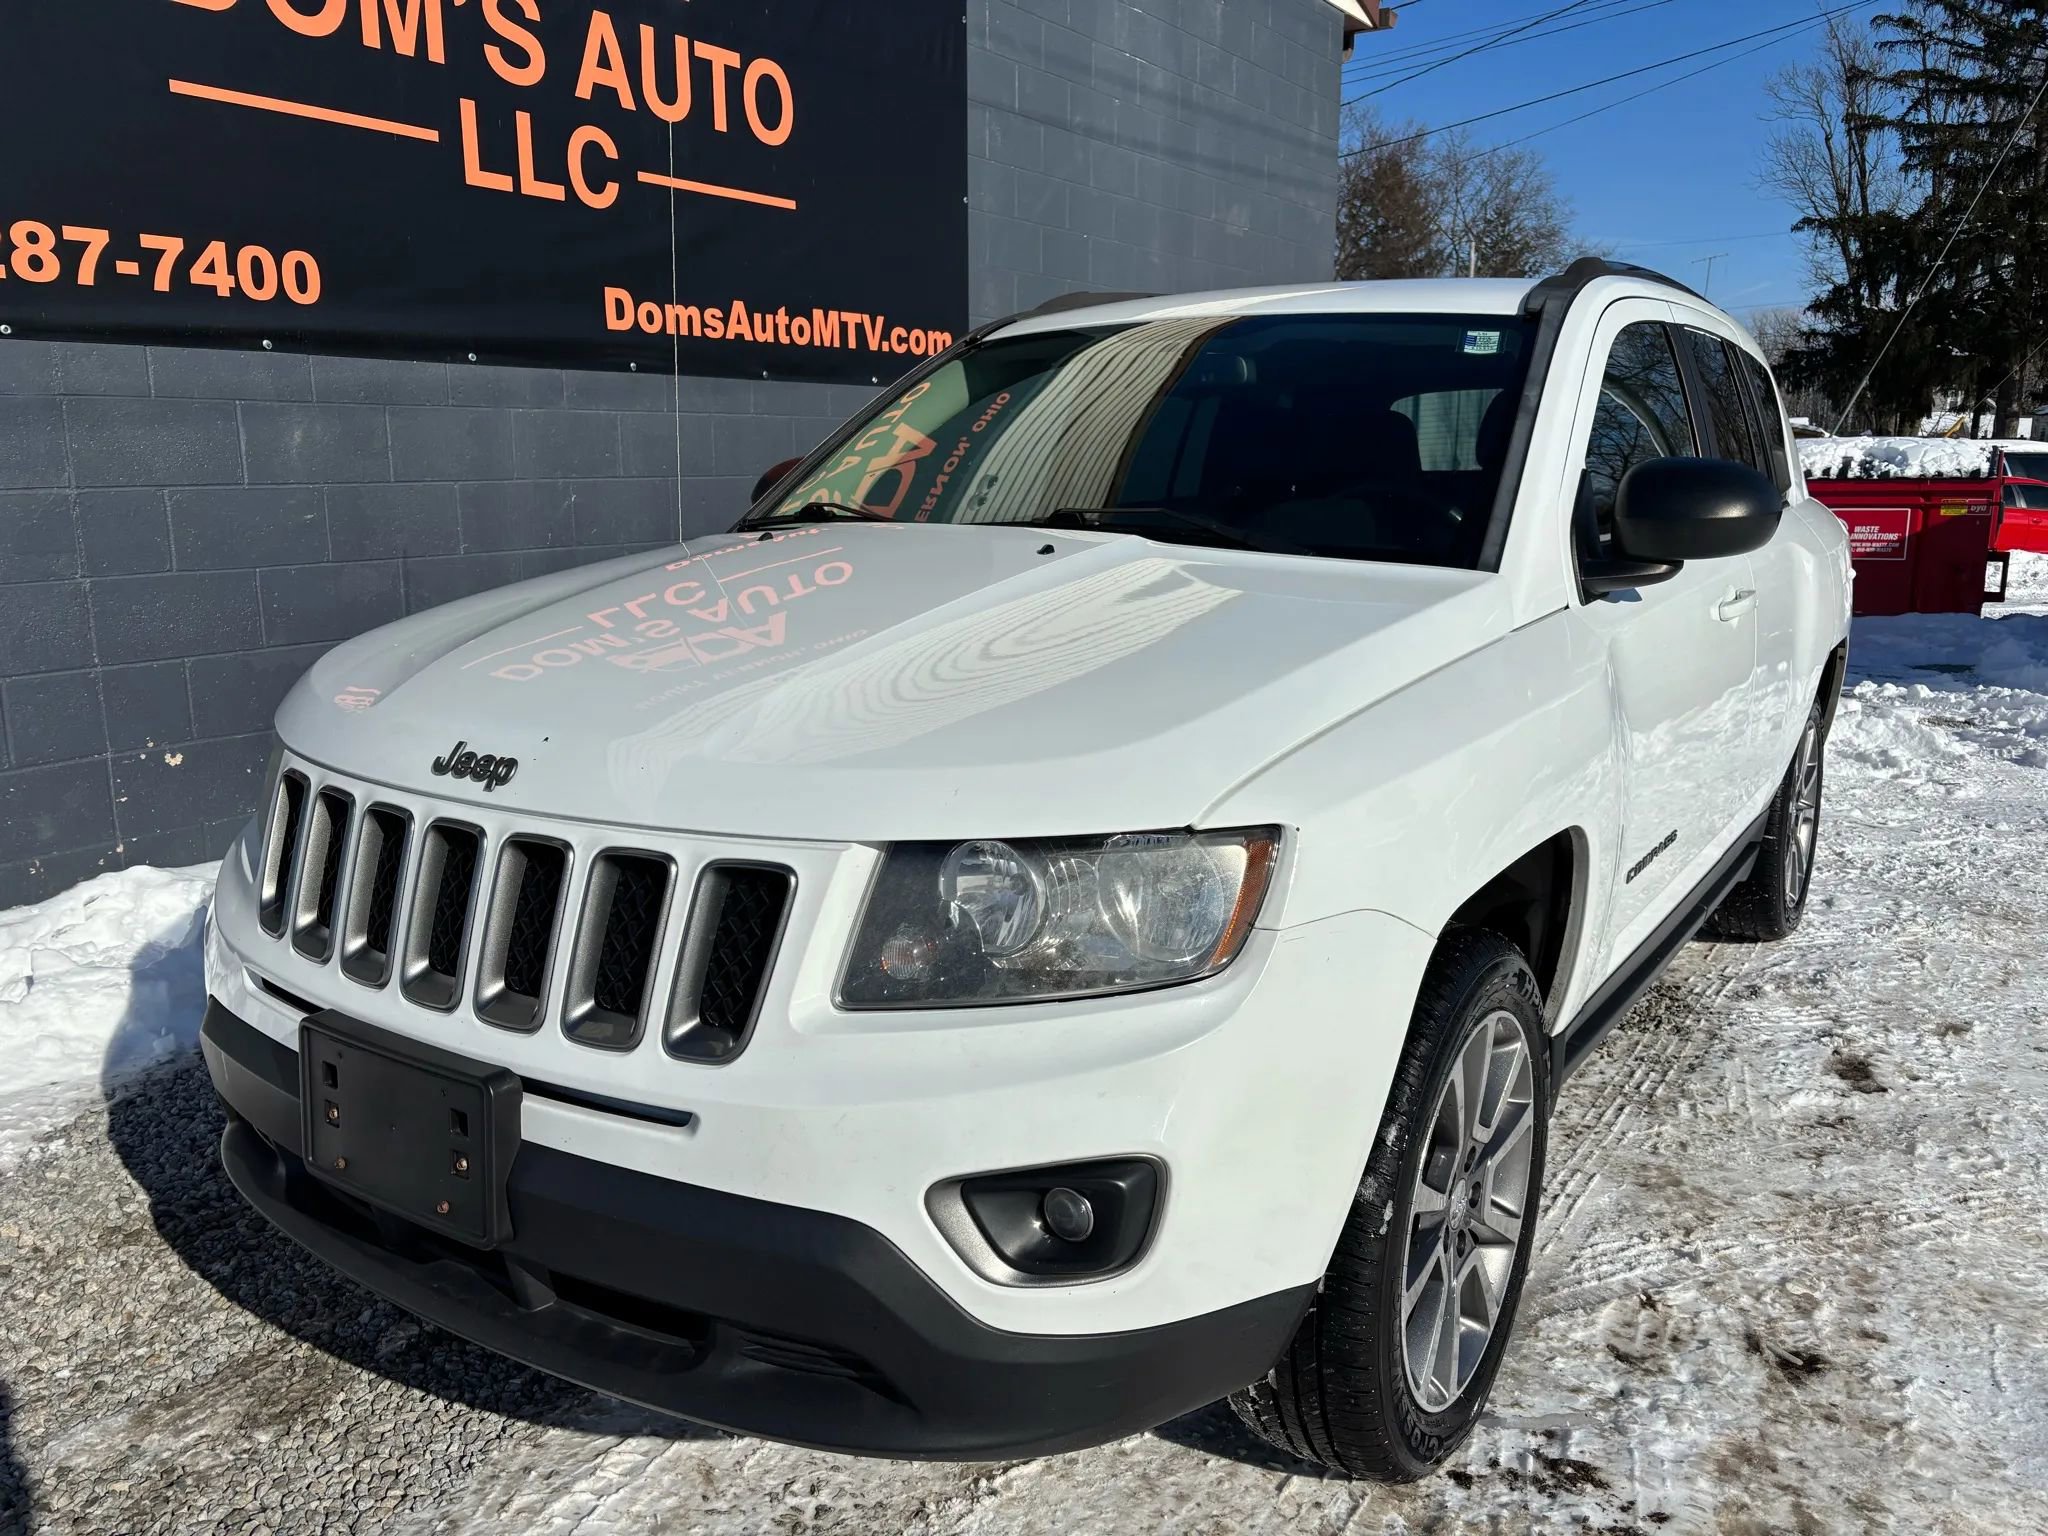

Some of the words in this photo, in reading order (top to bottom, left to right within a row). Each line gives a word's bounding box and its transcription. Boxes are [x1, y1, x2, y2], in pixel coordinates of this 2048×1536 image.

[575, 10, 794, 146] AUTO
[460, 98, 619, 209] LLC
[0, 220, 321, 304] 87-7400
[604, 286, 952, 356] DomsAutoMTV.com
[431, 741, 518, 792] Jeep
[1626, 829, 1678, 884] COMPASS
